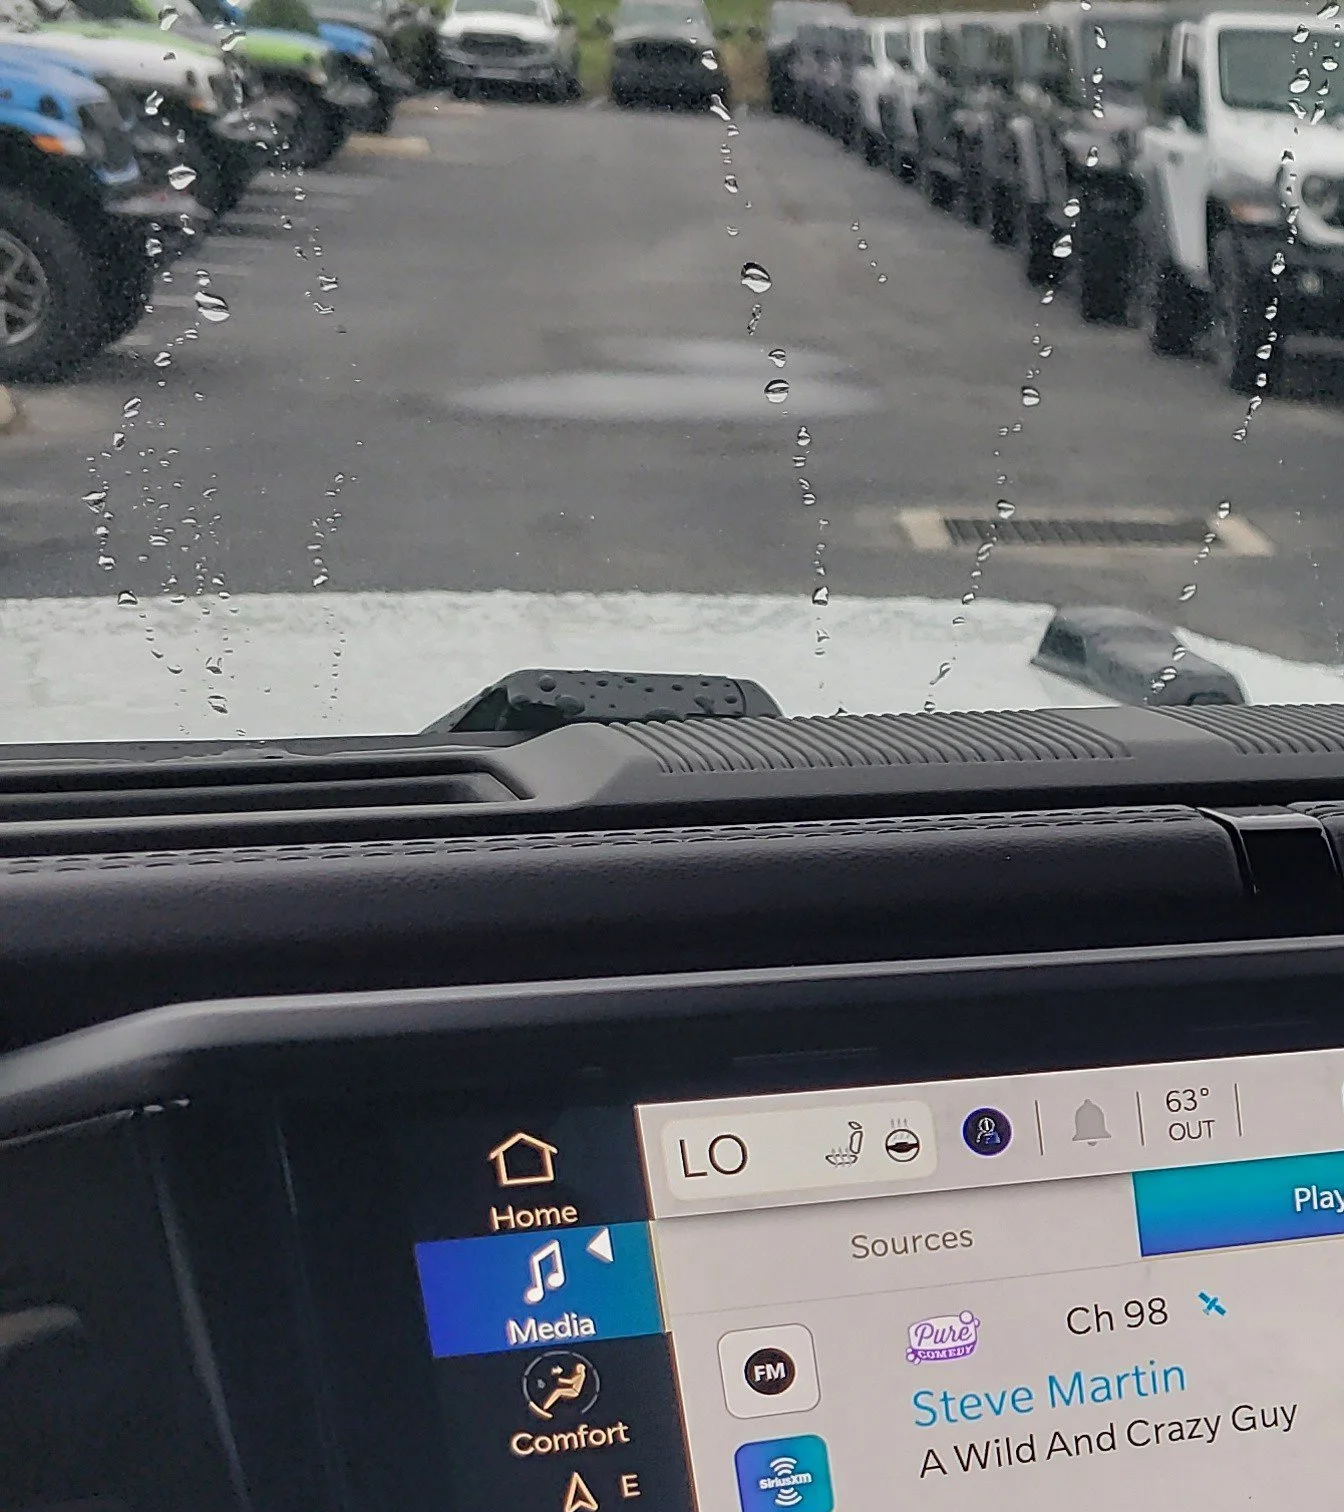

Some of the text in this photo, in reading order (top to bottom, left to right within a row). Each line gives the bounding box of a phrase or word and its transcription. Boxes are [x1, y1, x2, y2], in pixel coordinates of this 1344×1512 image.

[1167, 1118, 1215, 1143] OUT
[679, 1132, 750, 1181] LO
[489, 1199, 580, 1232] Home
[850, 1225, 975, 1262] Sources
[506, 1310, 597, 1346] Media
[914, 1321, 973, 1347] Pure
[1066, 1299, 1169, 1335] Ch 98
[754, 1362, 786, 1382] FM
[912, 1359, 1186, 1428] Steve Martin
[511, 1420, 631, 1458] Comfort
[919, 1398, 1297, 1480] A Wild And Crazy Guy
[621, 1474, 641, 1500] E
